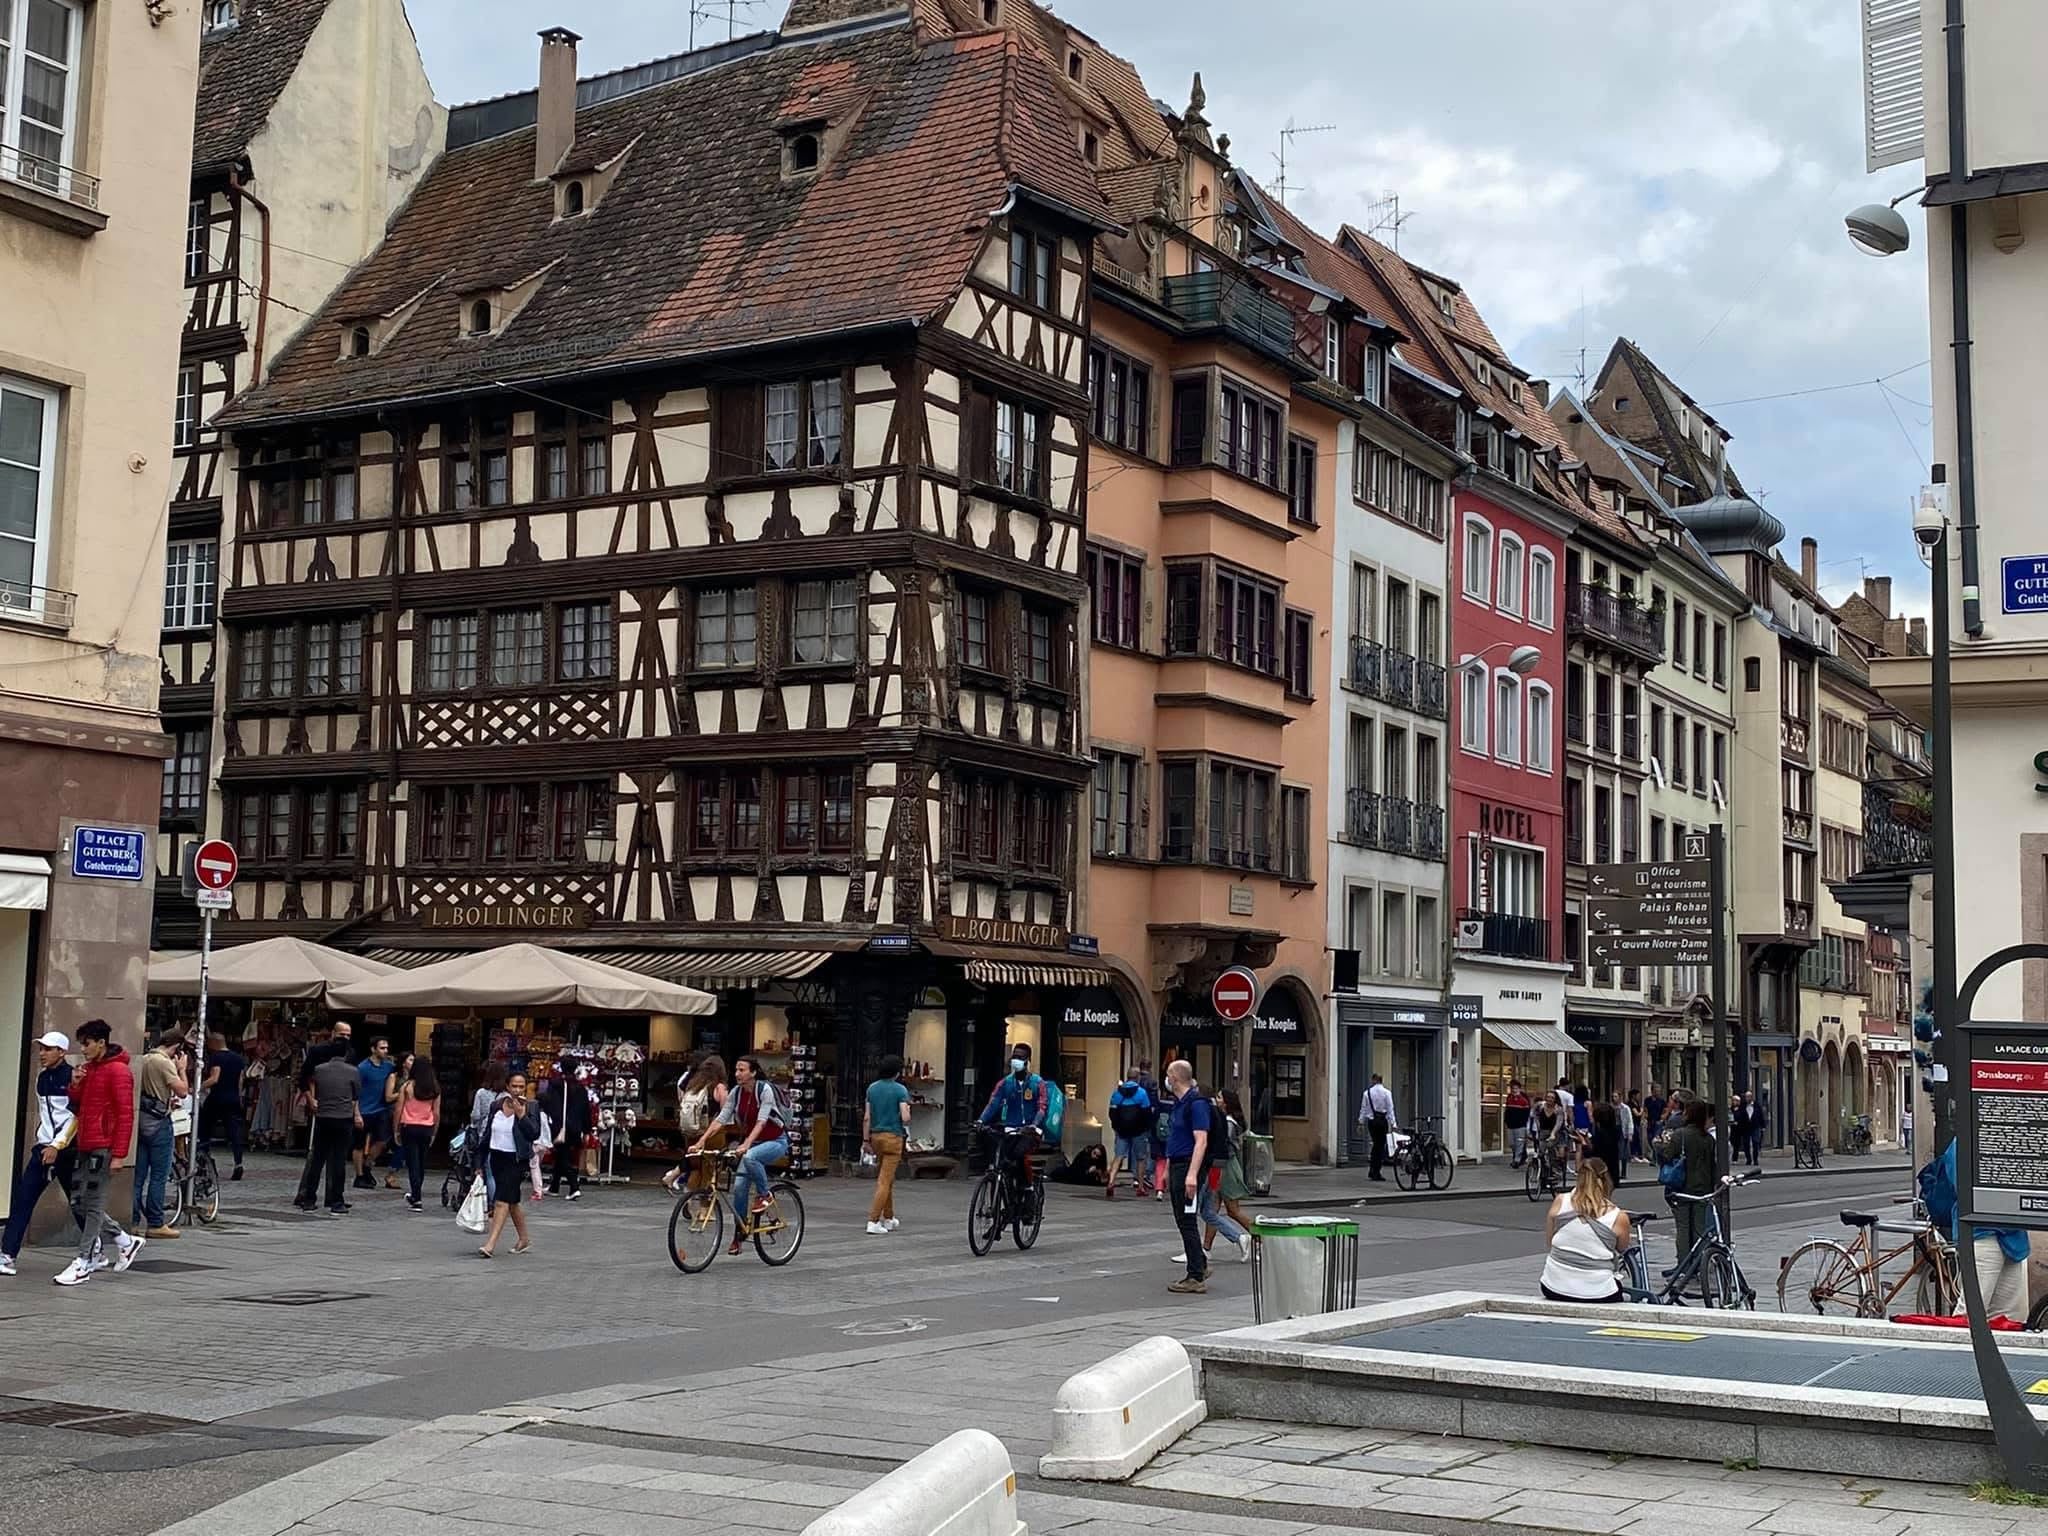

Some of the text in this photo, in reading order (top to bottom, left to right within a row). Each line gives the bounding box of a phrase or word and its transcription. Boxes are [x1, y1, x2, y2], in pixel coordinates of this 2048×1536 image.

[1480, 802, 1536, 842] HOTEL
[96, 834, 126, 847] PLACE
[82, 846, 137, 860] GUTENBERG
[1651, 866, 1681, 876] Office
[1664, 880, 1707, 889] tourisme
[1640, 902, 1708, 912] Palais Rohan
[1652, 939, 1708, 949] Notre-Dame
[1064, 1007, 1120, 1026] The Kooples
[1268, 1016, 1297, 1032] Kooples
[1994, 1045, 2005, 1053] LA
[2006, 1045, 2031, 1053] PLACE
